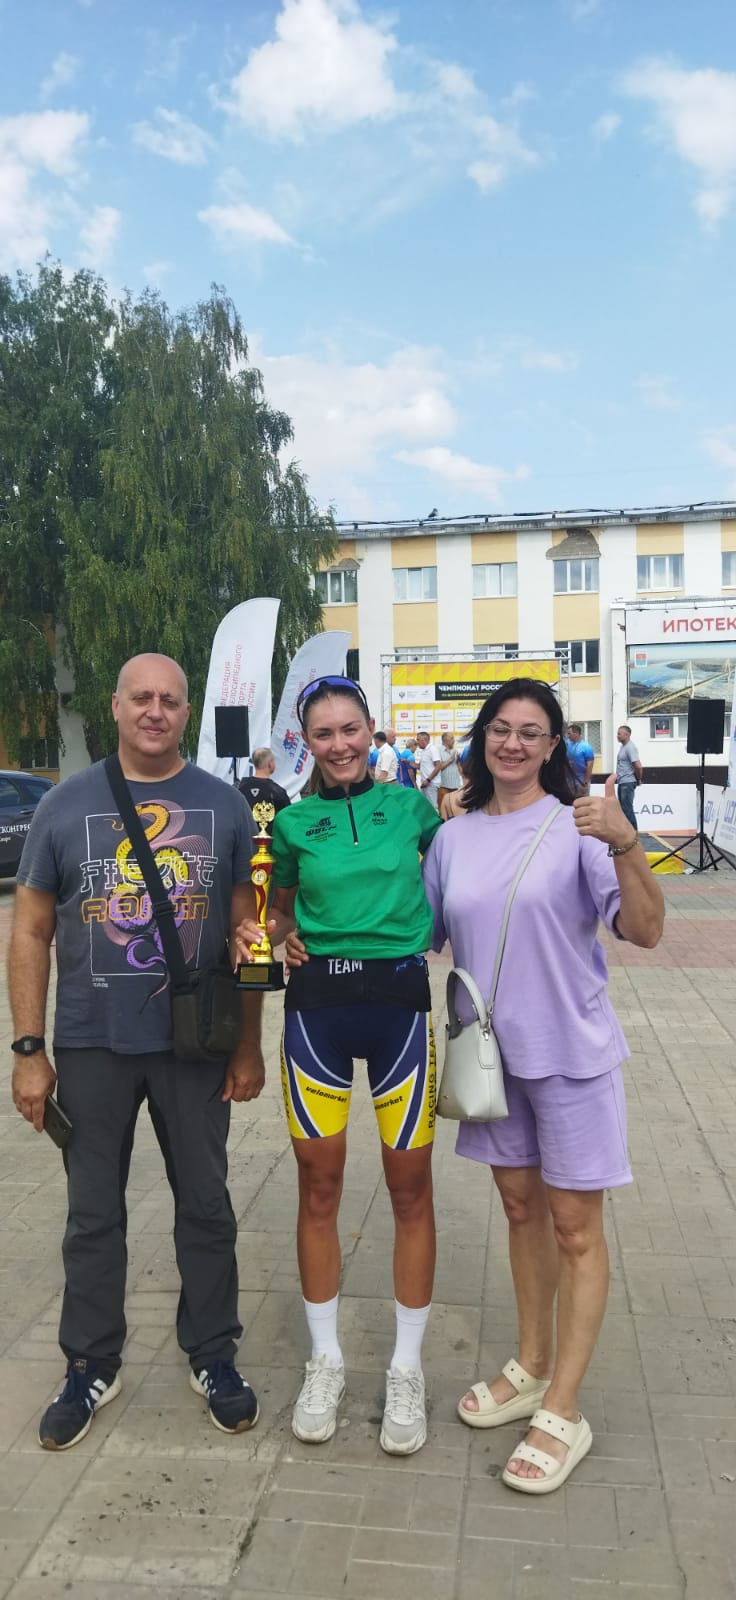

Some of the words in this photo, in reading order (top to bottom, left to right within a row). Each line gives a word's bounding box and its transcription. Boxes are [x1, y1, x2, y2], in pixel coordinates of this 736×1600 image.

[663, 617, 736, 632] ИПОТЕК
[229, 644, 242, 704] ЕЛОСИПЕДНОГО
[237, 682, 247, 706] ПОРТА
[438, 684, 480, 692] ЧЕМПИОНАТ
[0, 823, 32, 834] КОНГРЕС
[328, 958, 363, 975] TEAM
